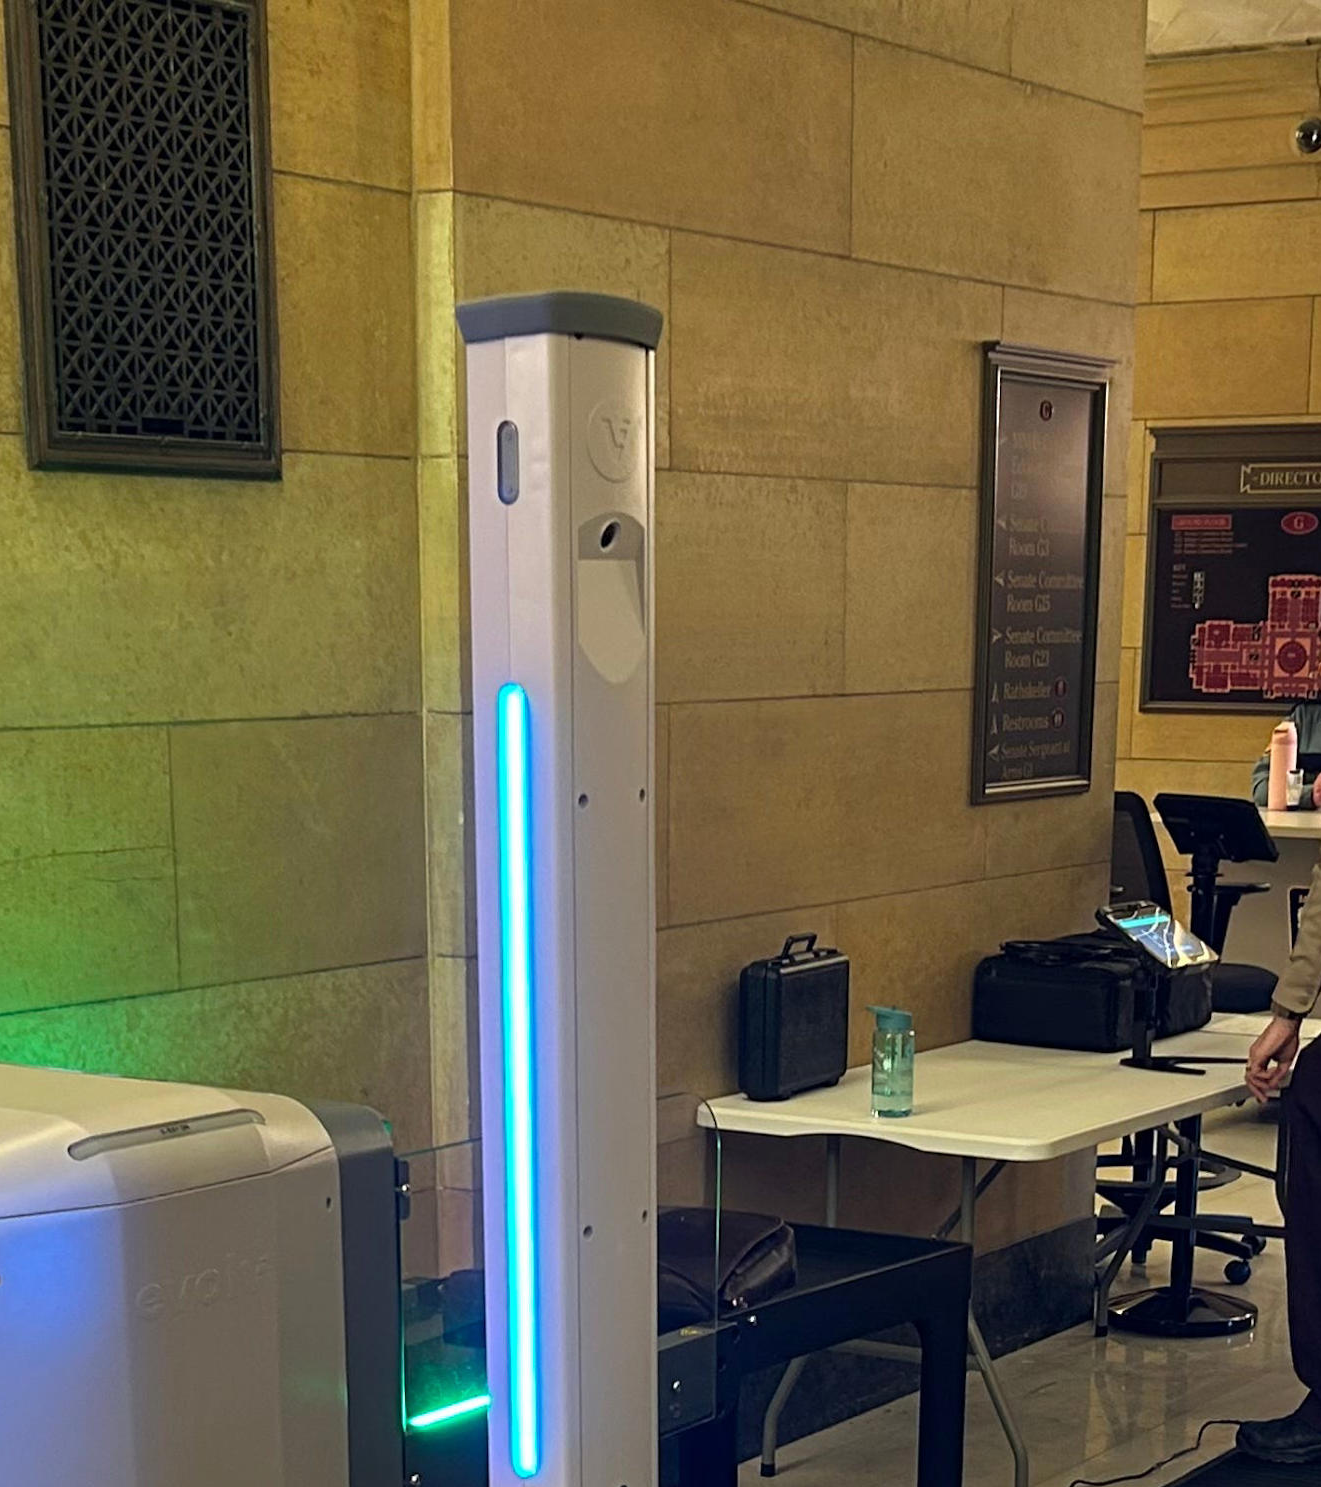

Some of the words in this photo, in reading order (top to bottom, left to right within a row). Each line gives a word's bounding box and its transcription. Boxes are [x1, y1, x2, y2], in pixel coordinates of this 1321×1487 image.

[1006, 569, 1037, 589] Senate
[1006, 593, 1033, 613] Room
[1005, 625, 1036, 645] Senate
[1037, 625, 1083, 644] Committee
[1005, 649, 1031, 669] Room
[1002, 713, 1049, 732] Restrooms
